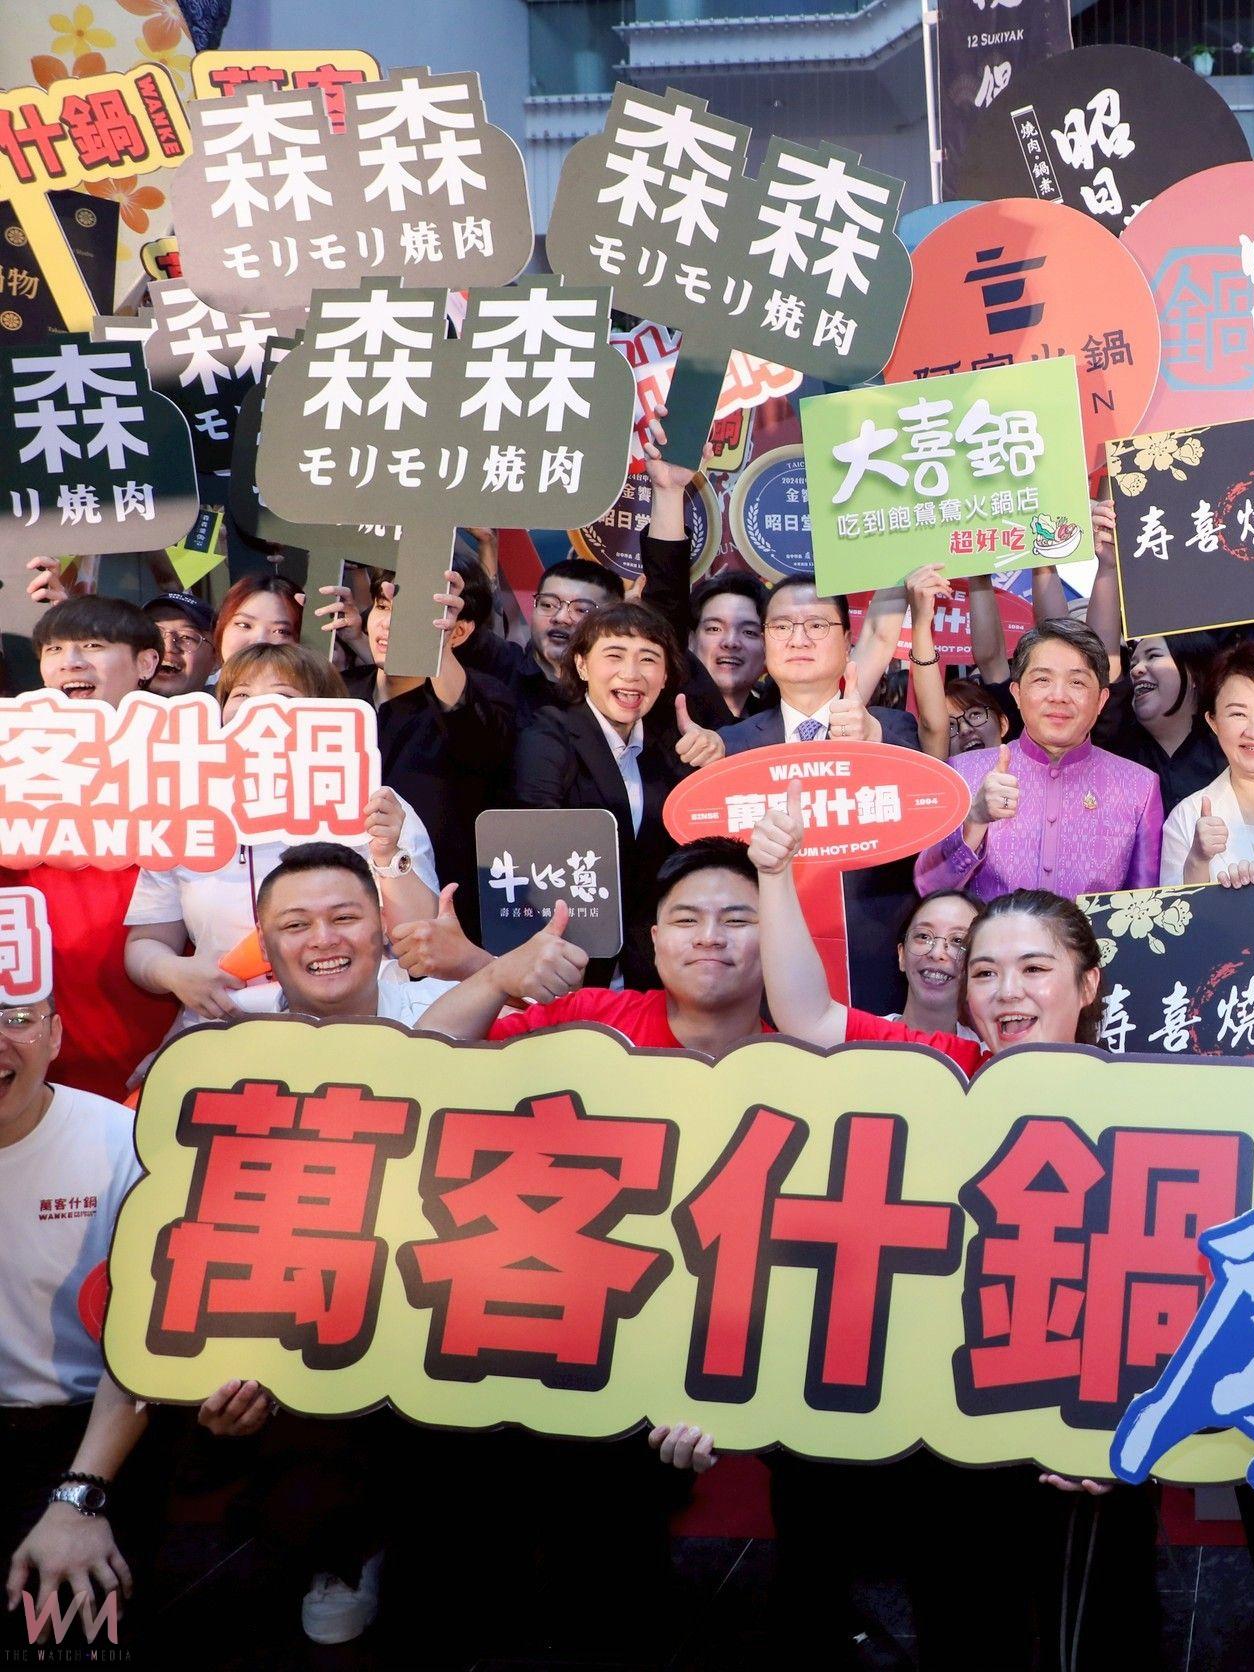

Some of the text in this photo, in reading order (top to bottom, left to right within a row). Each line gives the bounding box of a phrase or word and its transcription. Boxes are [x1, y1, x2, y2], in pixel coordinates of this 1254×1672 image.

[967, 35, 978, 48] 12
[135, 75, 181, 157] WANKE
[201, 77, 487, 228] 森森
[597, 99, 890, 298] 森森
[222, 217, 494, 279] モリモリ焼肉
[589, 235, 858, 355] モリモリ焼肉
[303, 288, 597, 431] 森森
[12, 344, 149, 474] 森
[299, 445, 585, 494] モリモリ焼肉
[832, 397, 1045, 504] 大喜鍋
[837, 487, 1039, 538] 吃到飽鴛鴦火鍋店
[949, 528, 1027, 555] 超好吃
[769, 761, 851, 781] WANKE
[0, 818, 217, 858] WANKE
[821, 844, 847, 857] HOT
[851, 840, 878, 853] POT
[160, 1082, 1242, 1404] 萬客什鍋
